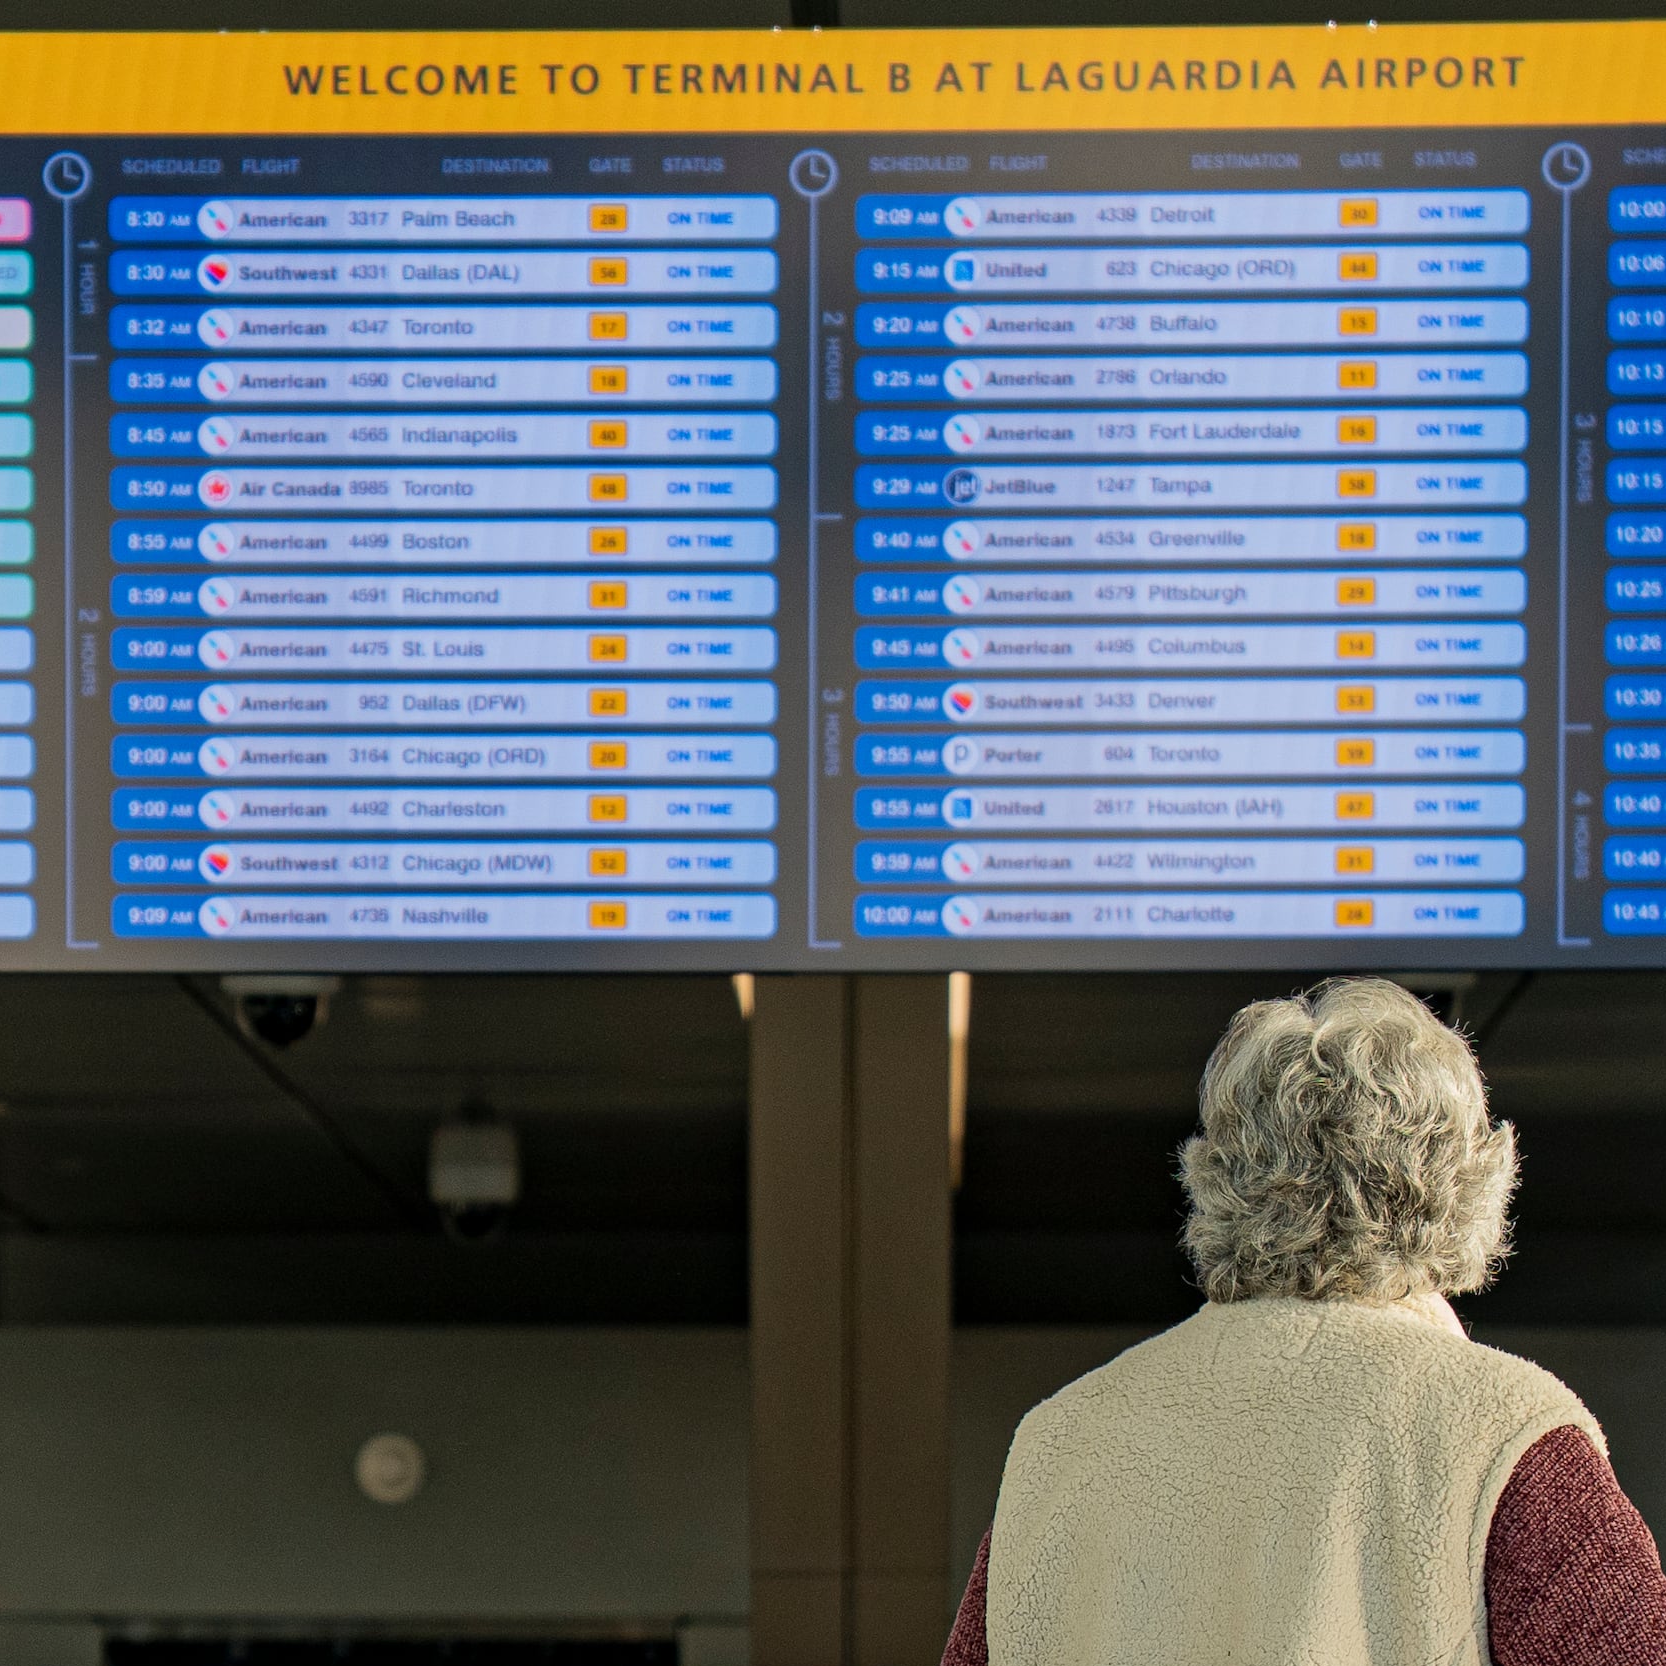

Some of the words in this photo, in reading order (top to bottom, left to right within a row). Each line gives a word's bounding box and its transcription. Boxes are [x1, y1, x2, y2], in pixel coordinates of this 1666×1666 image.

[284, 64, 516, 96] WELCOME
[541, 64, 599, 95] TO
[625, 63, 863, 94] TERMINAL
[889, 63, 911, 93] B
[935, 62, 991, 92] AT
[1017, 60, 1295, 92] LAGUARDIA
[1321, 56, 1525, 90] AIRPORT
[401, 210, 449, 228] Palm
[456, 210, 515, 228] Beach
[1151, 206, 1214, 224] Detroit
[239, 266, 337, 281] Southwest
[403, 264, 461, 281] Dallas
[403, 318, 473, 336] Toronto
[1151, 315, 1217, 332] Buffalo
[403, 372, 497, 389] Cleveland
[403, 427, 518, 446] Indianapolis
[1149, 424, 1185, 440] Fort
[1193, 424, 1301, 440] Lauderdale
[240, 482, 267, 497] Air
[272, 482, 341, 497] Canada
[1150, 477, 1212, 496] Tampa
[403, 533, 469, 550] Boston
[403, 588, 499, 604] Richmond
[1149, 585, 1247, 606] Pittsburgh
[402, 640, 428, 658] St.
[433, 642, 485, 658] Louis
[1149, 692, 1215, 709] Denver
[1148, 854, 1255, 874] Wilmington
[403, 908, 489, 924] Nashville
